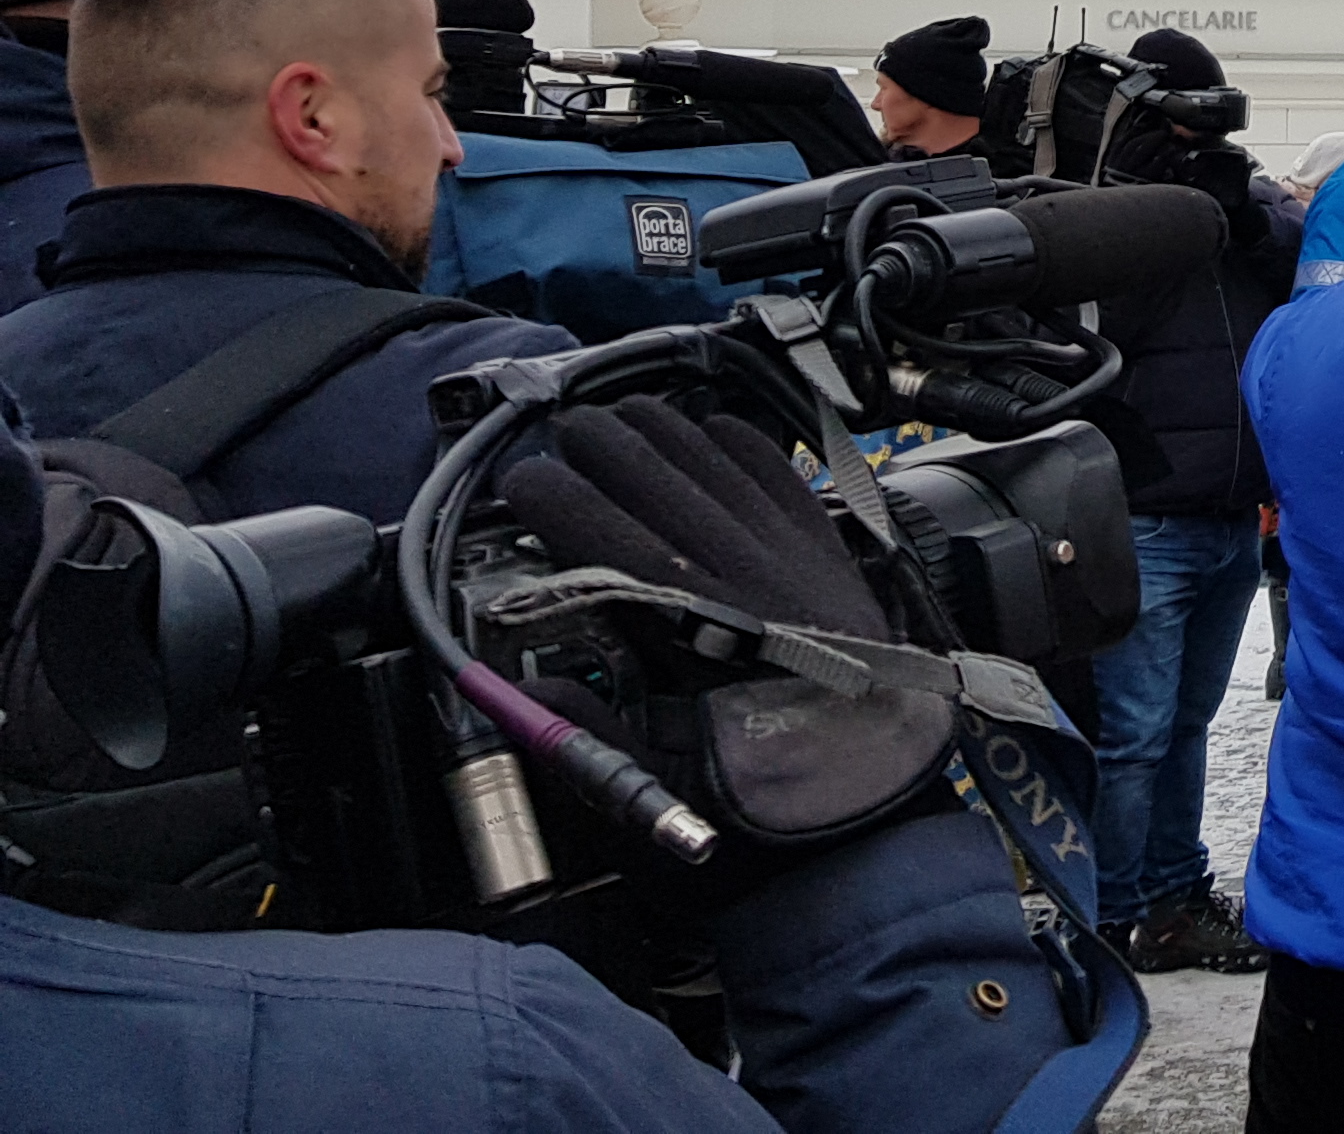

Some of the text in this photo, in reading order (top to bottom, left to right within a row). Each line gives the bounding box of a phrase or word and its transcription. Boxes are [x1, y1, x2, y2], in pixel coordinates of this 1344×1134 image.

[1106, 9, 1258, 31] CANCELARIE
[638, 210, 685, 235] porta
[641, 235, 687, 254] brace
